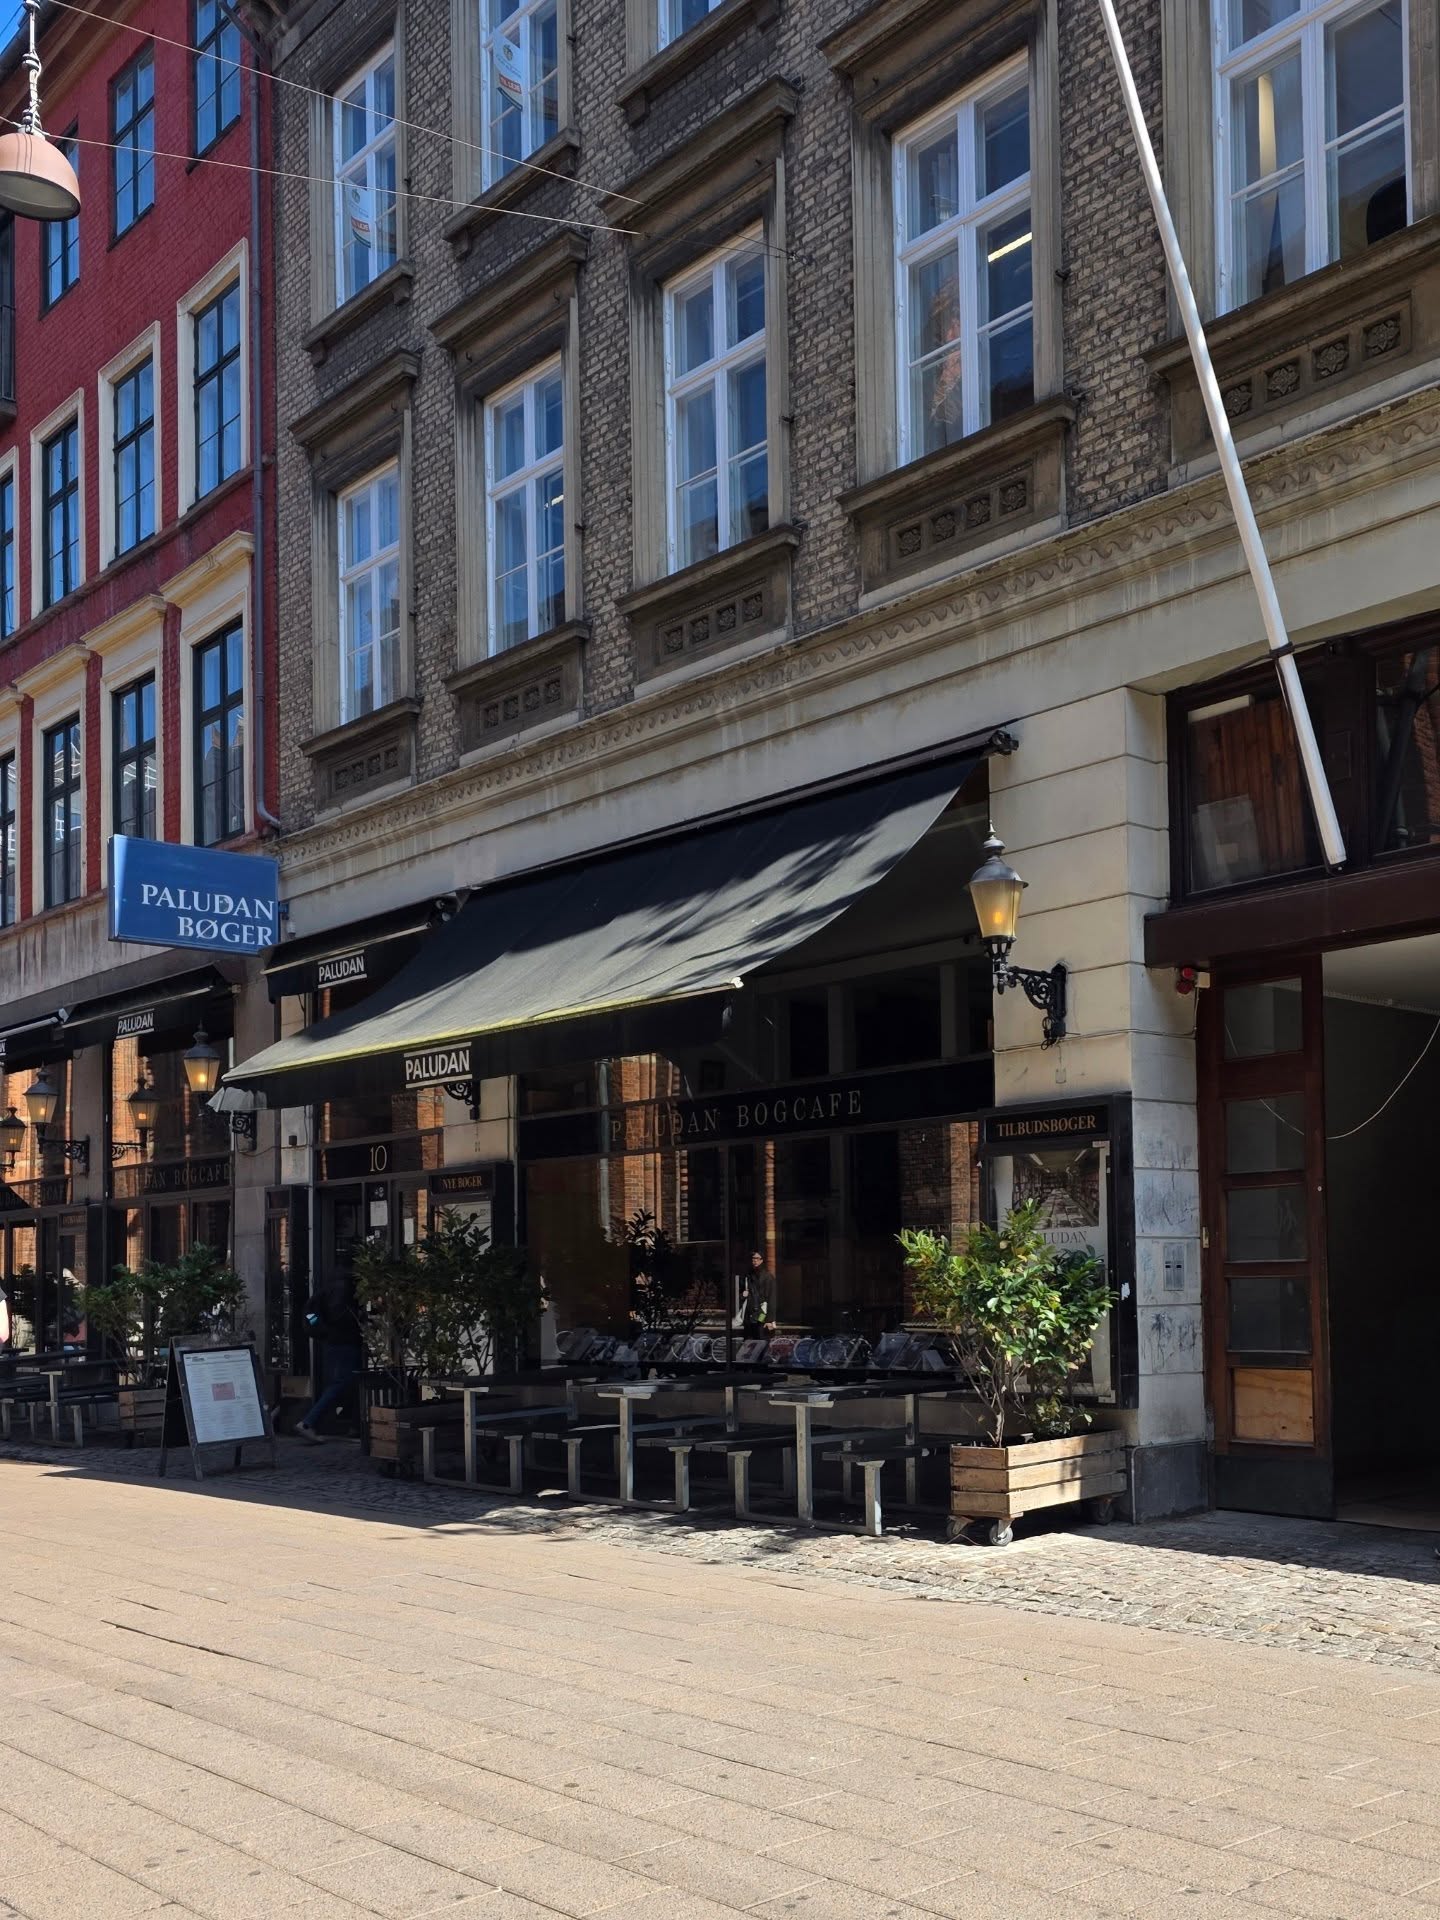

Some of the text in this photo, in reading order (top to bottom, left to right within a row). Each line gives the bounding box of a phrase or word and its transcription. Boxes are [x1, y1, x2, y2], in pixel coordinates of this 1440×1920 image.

[141, 883, 275, 921] PALUDAN
[177, 916, 273, 946] BØGER
[318, 956, 365, 982] PALUDAN
[117, 1013, 154, 1034] PALUDAN
[405, 1050, 470, 1081] PALUDAN
[736, 1090, 862, 1128] BOGCAFE
[369, 1145, 388, 1172] 10
